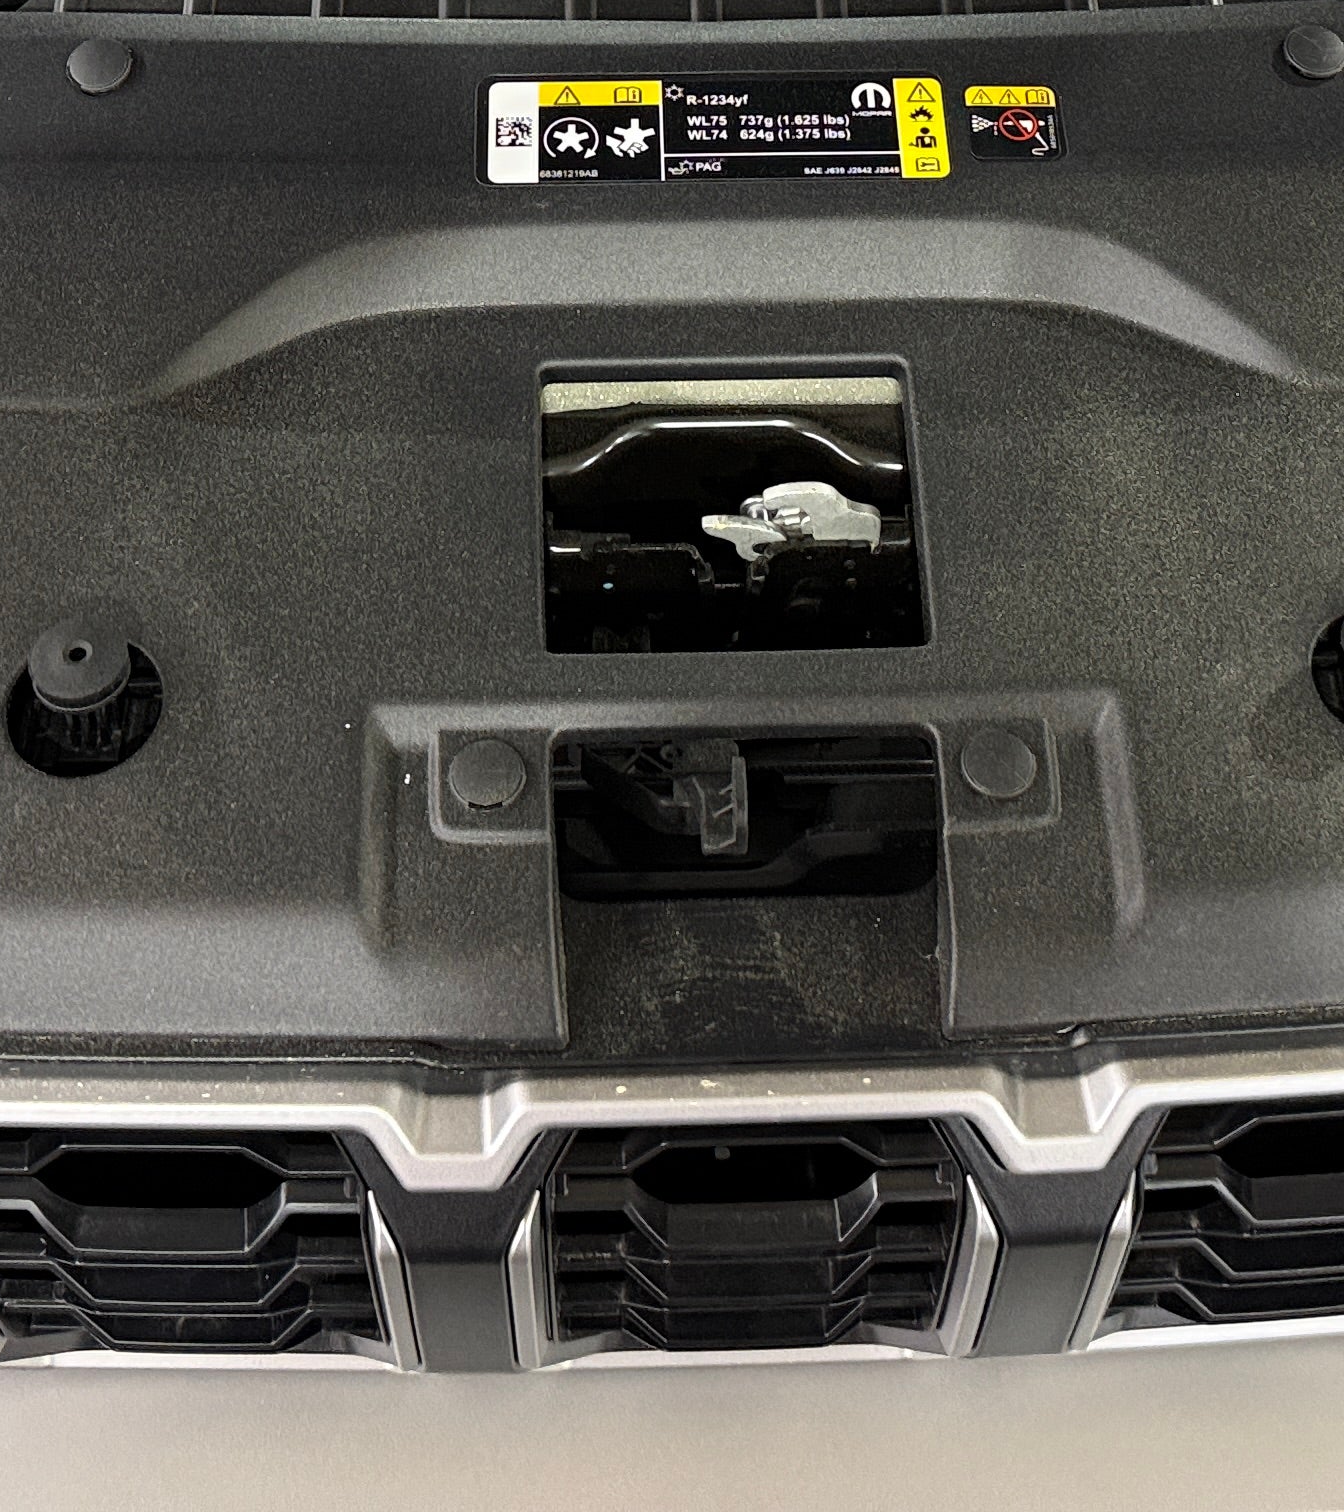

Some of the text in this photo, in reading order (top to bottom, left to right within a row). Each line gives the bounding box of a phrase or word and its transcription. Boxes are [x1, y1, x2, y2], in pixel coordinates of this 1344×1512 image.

[686, 94, 749, 107] R-1234yf
[686, 113, 850, 128] WL75 737g (1.625 lbs)
[687, 128, 851, 142] WL74 624g (1.375 lbs)
[695, 161, 722, 172] PAG
